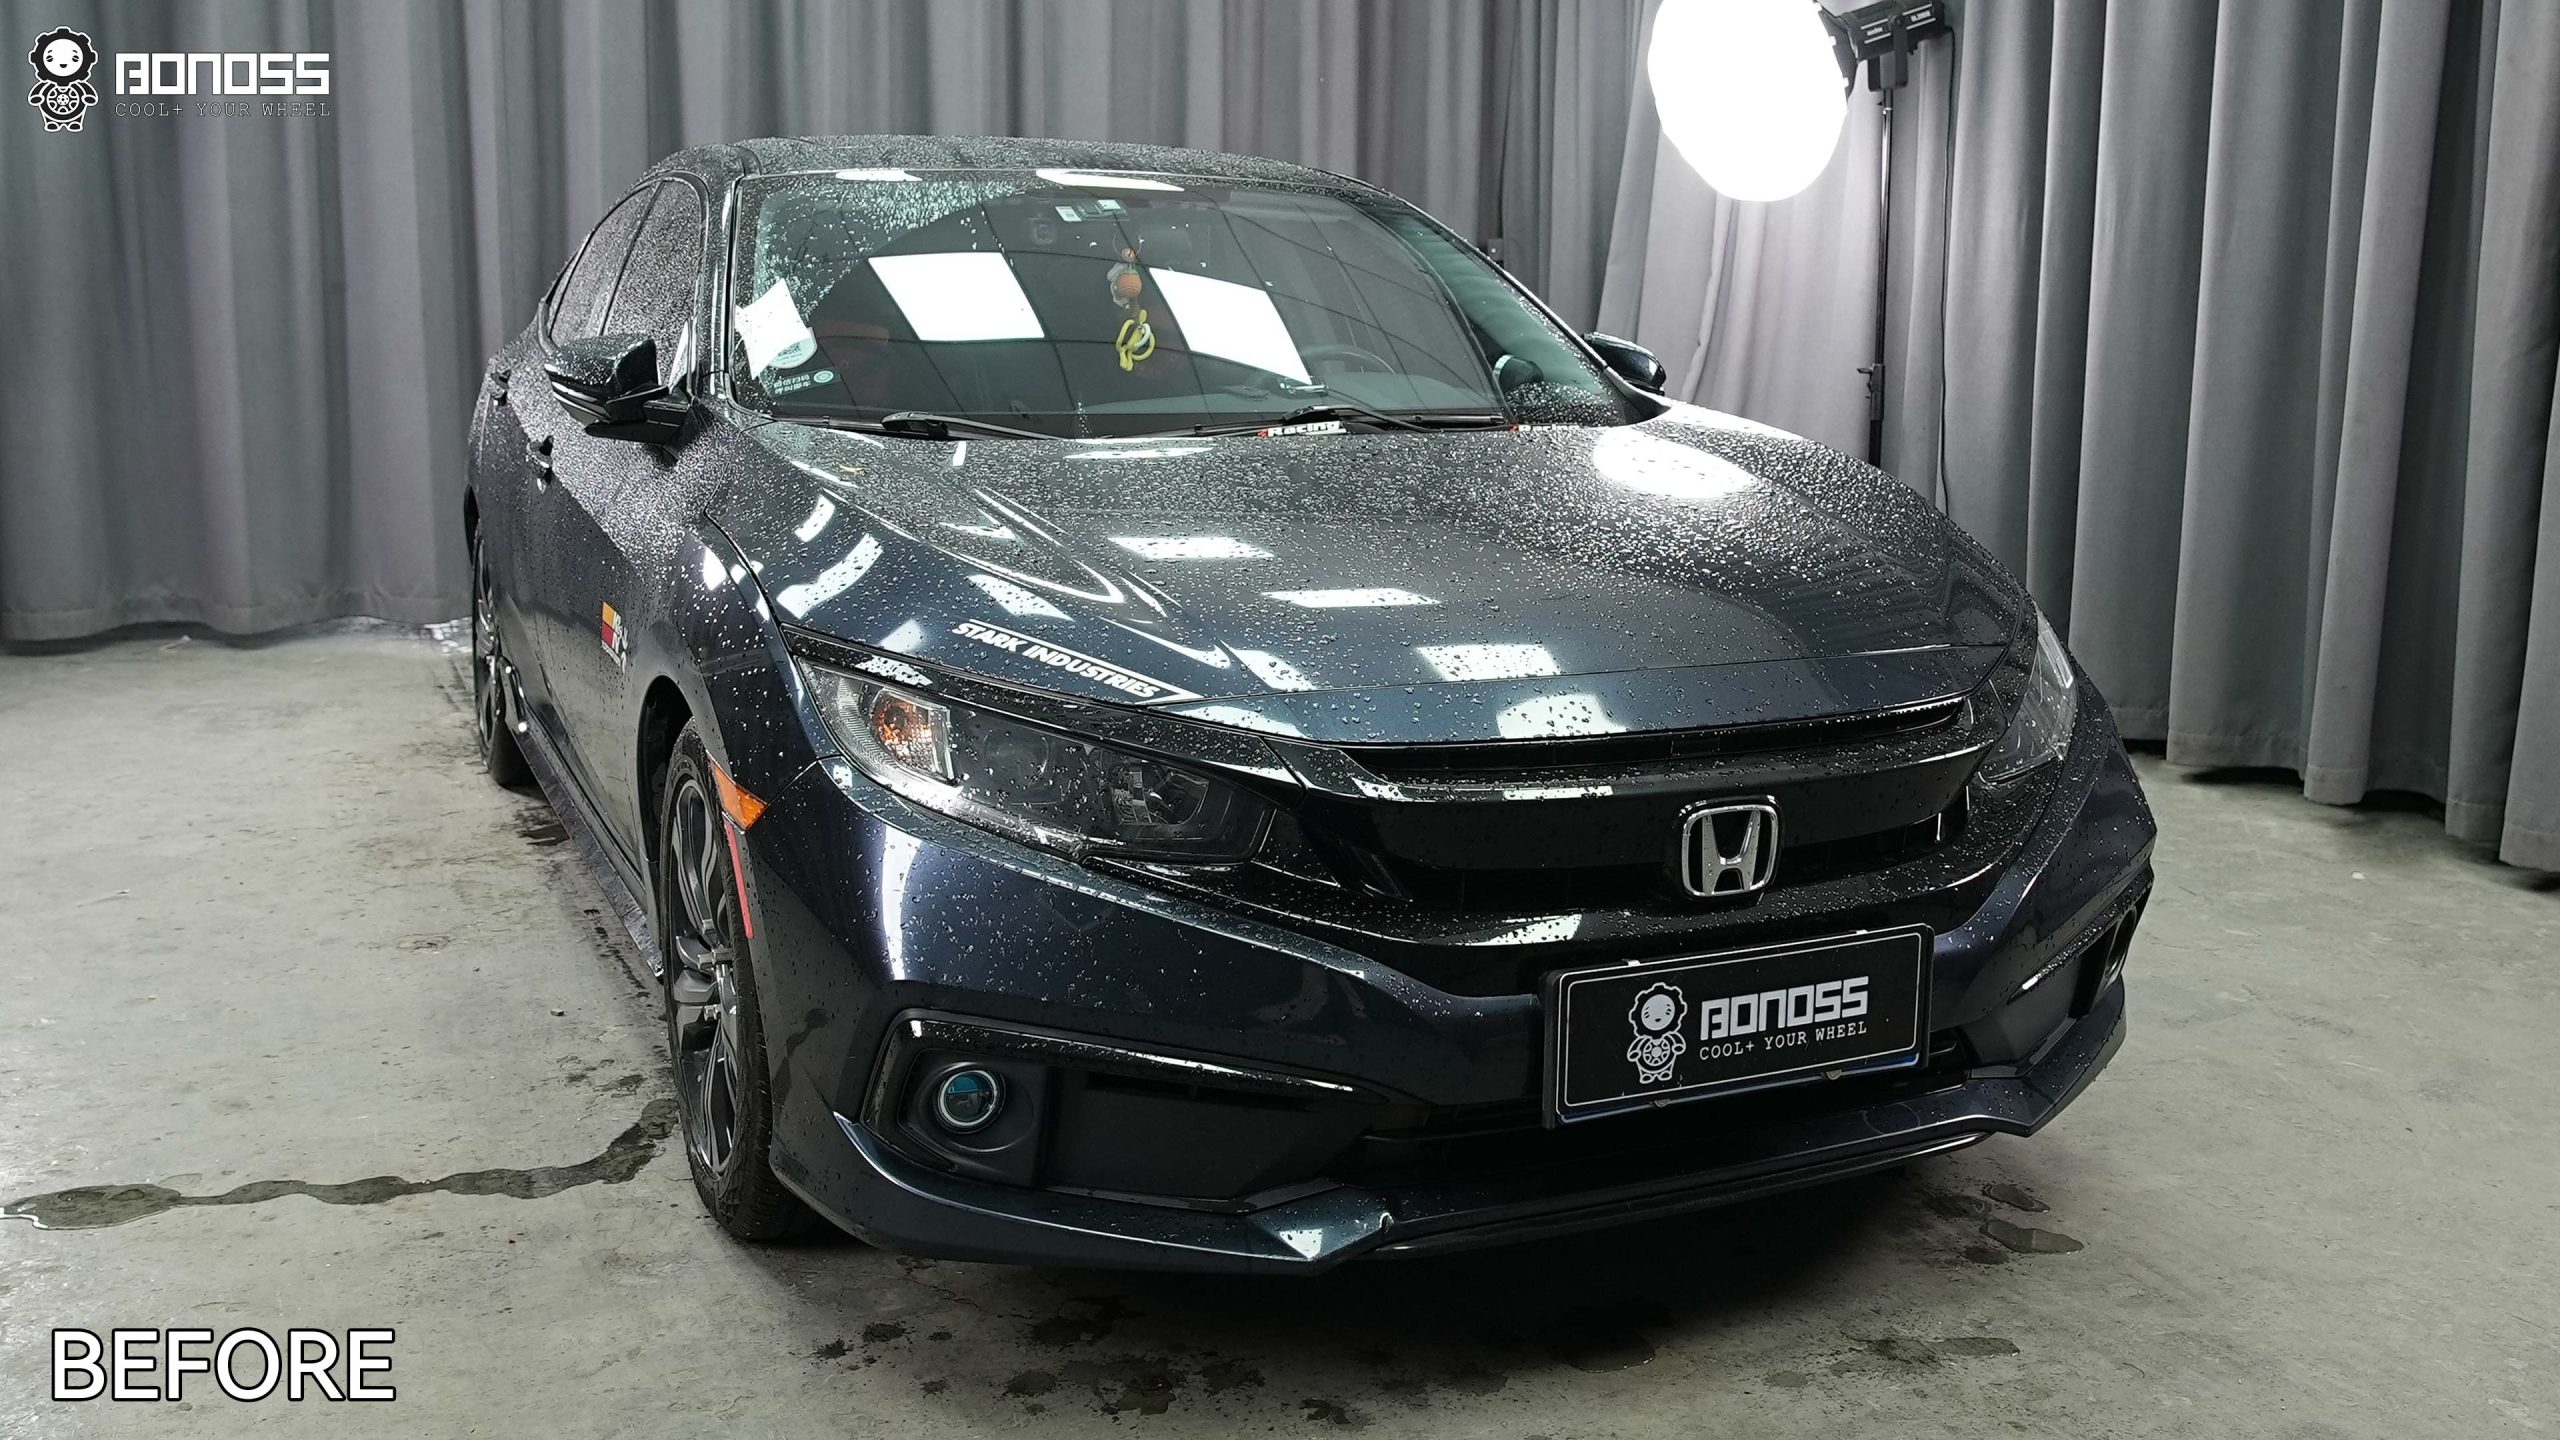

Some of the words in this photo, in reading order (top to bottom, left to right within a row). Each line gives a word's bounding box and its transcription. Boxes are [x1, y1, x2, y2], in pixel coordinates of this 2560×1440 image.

[952, 621, 1027, 653] STARK
[1022, 643, 1161, 698] INDUSTRIES
[1699, 1040, 1755, 1061] COOL+
[1764, 1031, 1807, 1051] YOUR
[1815, 1020, 1867, 1042] WHEEL
[1700, 975, 1869, 1041] BONOSS
